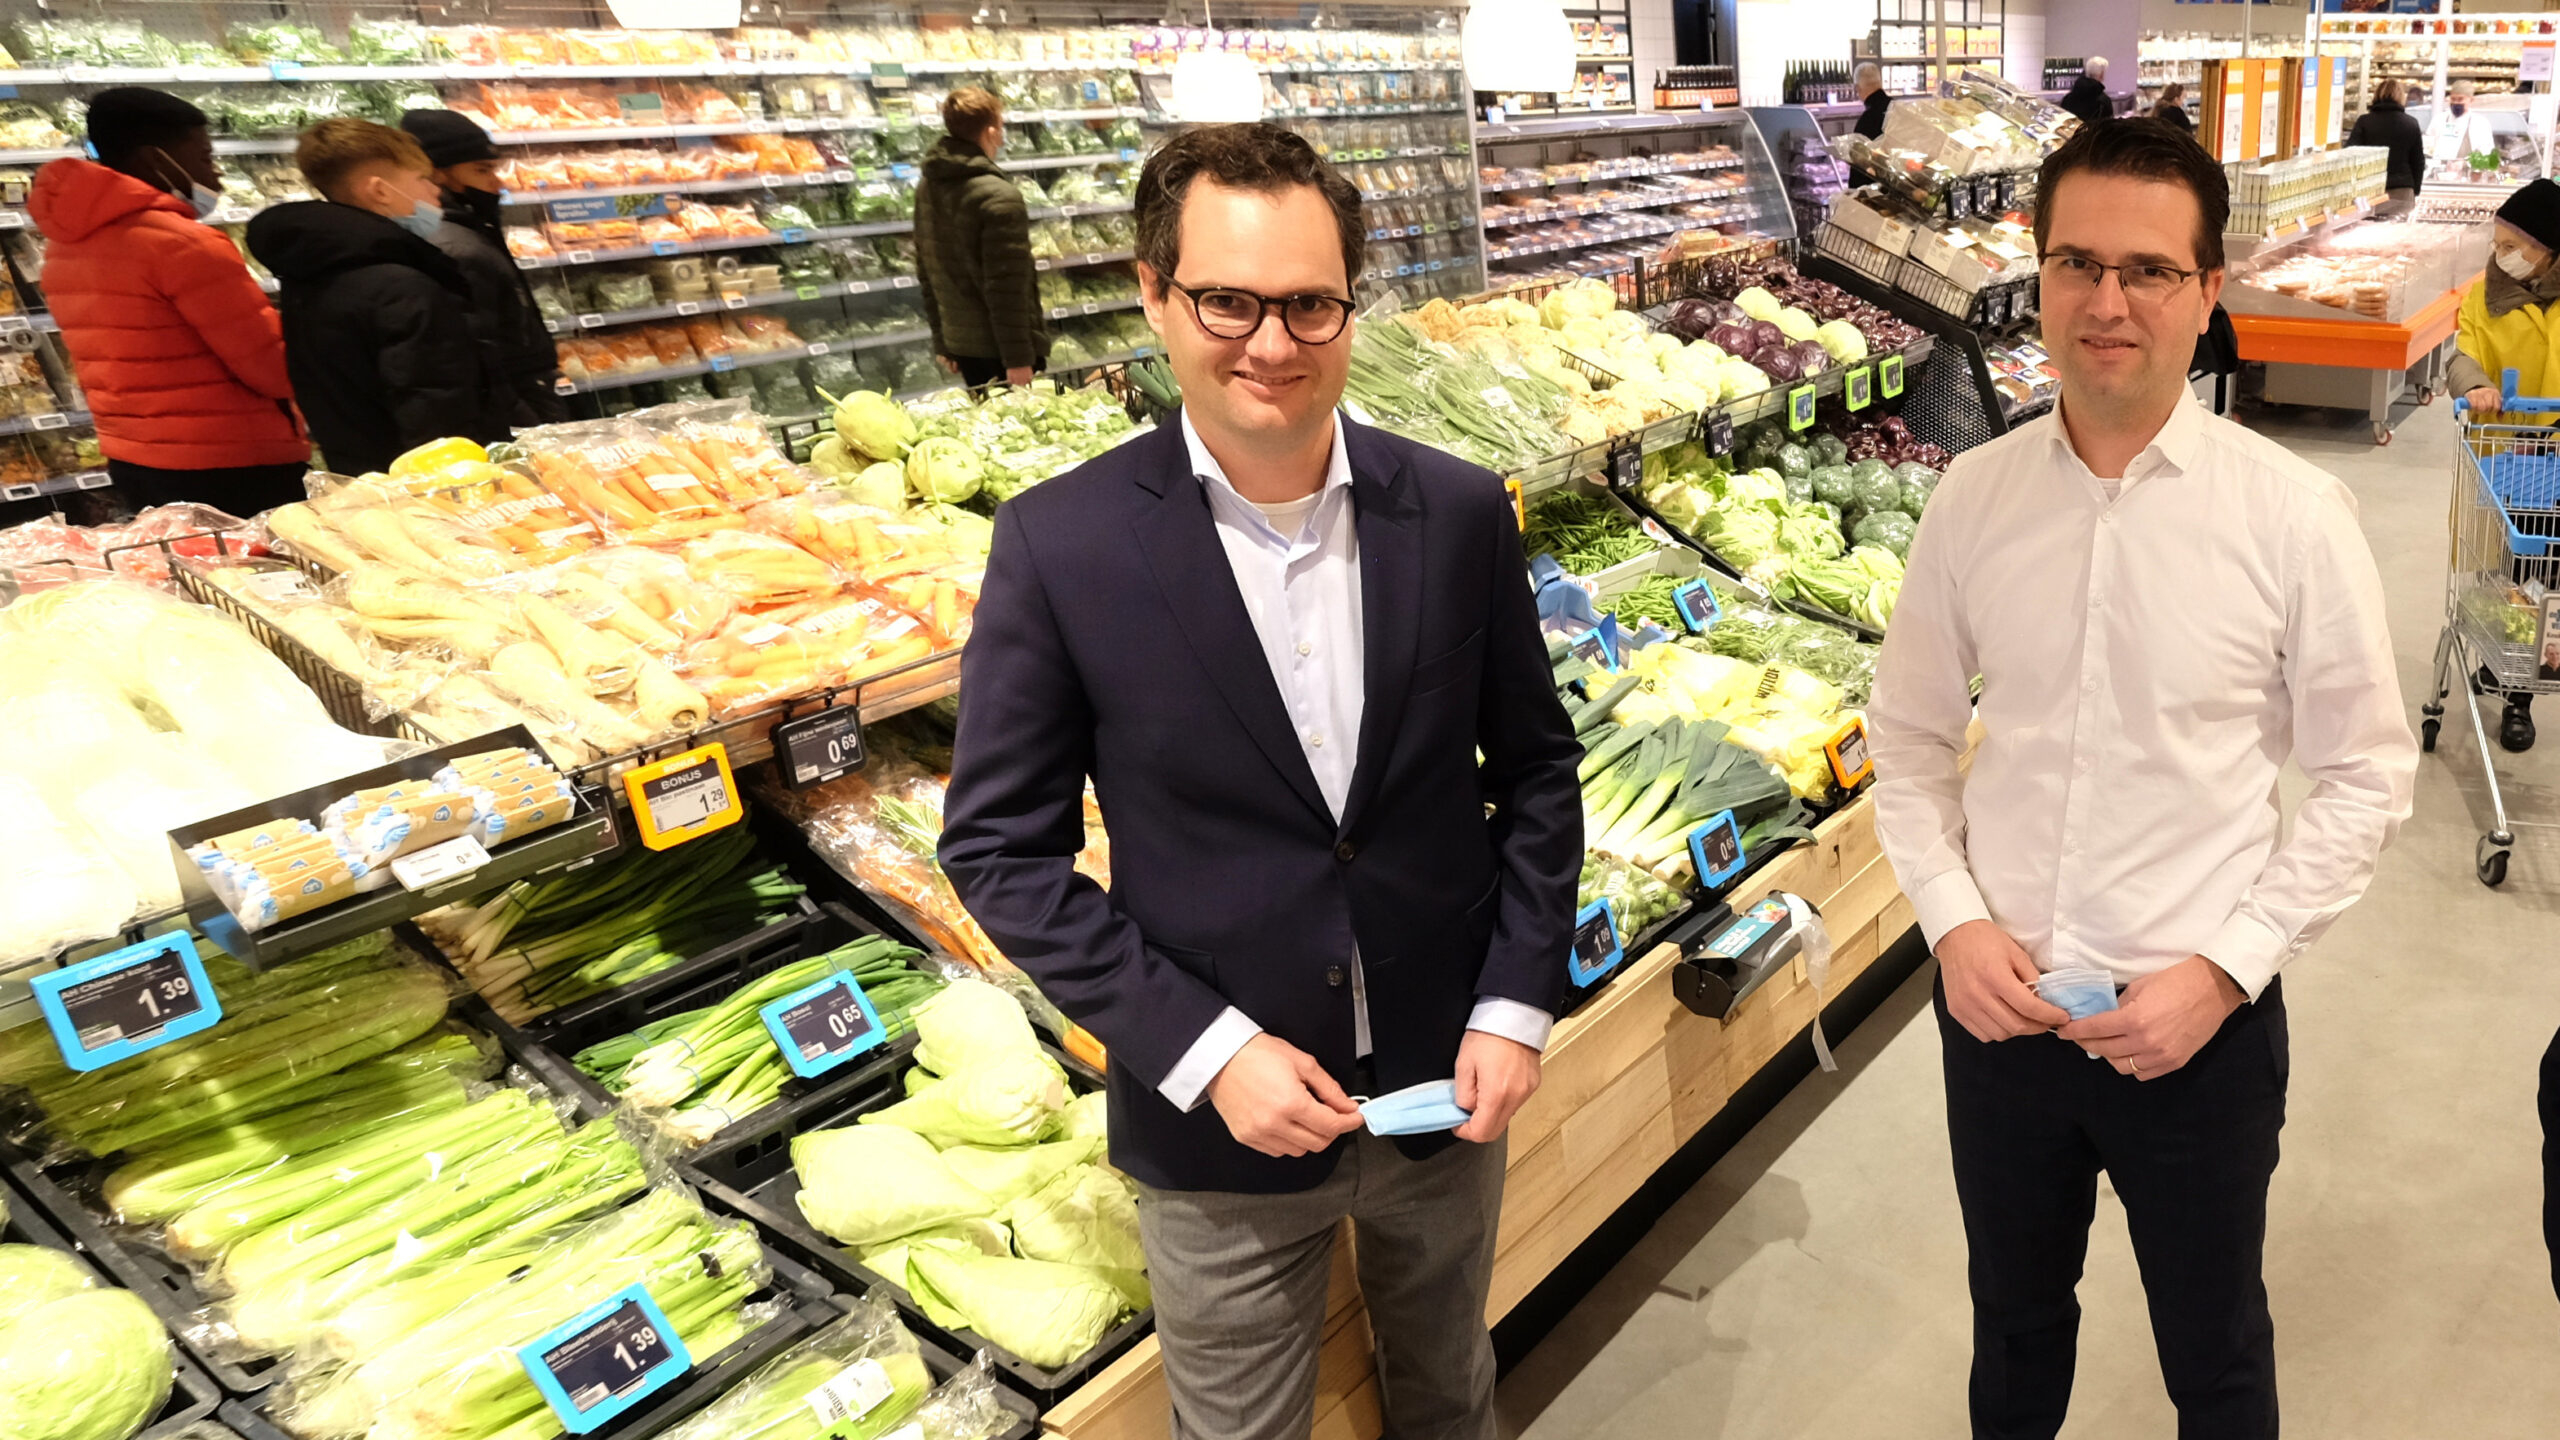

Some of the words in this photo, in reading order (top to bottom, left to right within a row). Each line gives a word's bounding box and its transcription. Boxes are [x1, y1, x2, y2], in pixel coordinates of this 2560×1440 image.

[1754, 667, 1780, 699] WITLOF
[660, 769, 702, 791] BONUS
[61, 987, 79, 999] AH
[127, 963, 152, 977] kool
